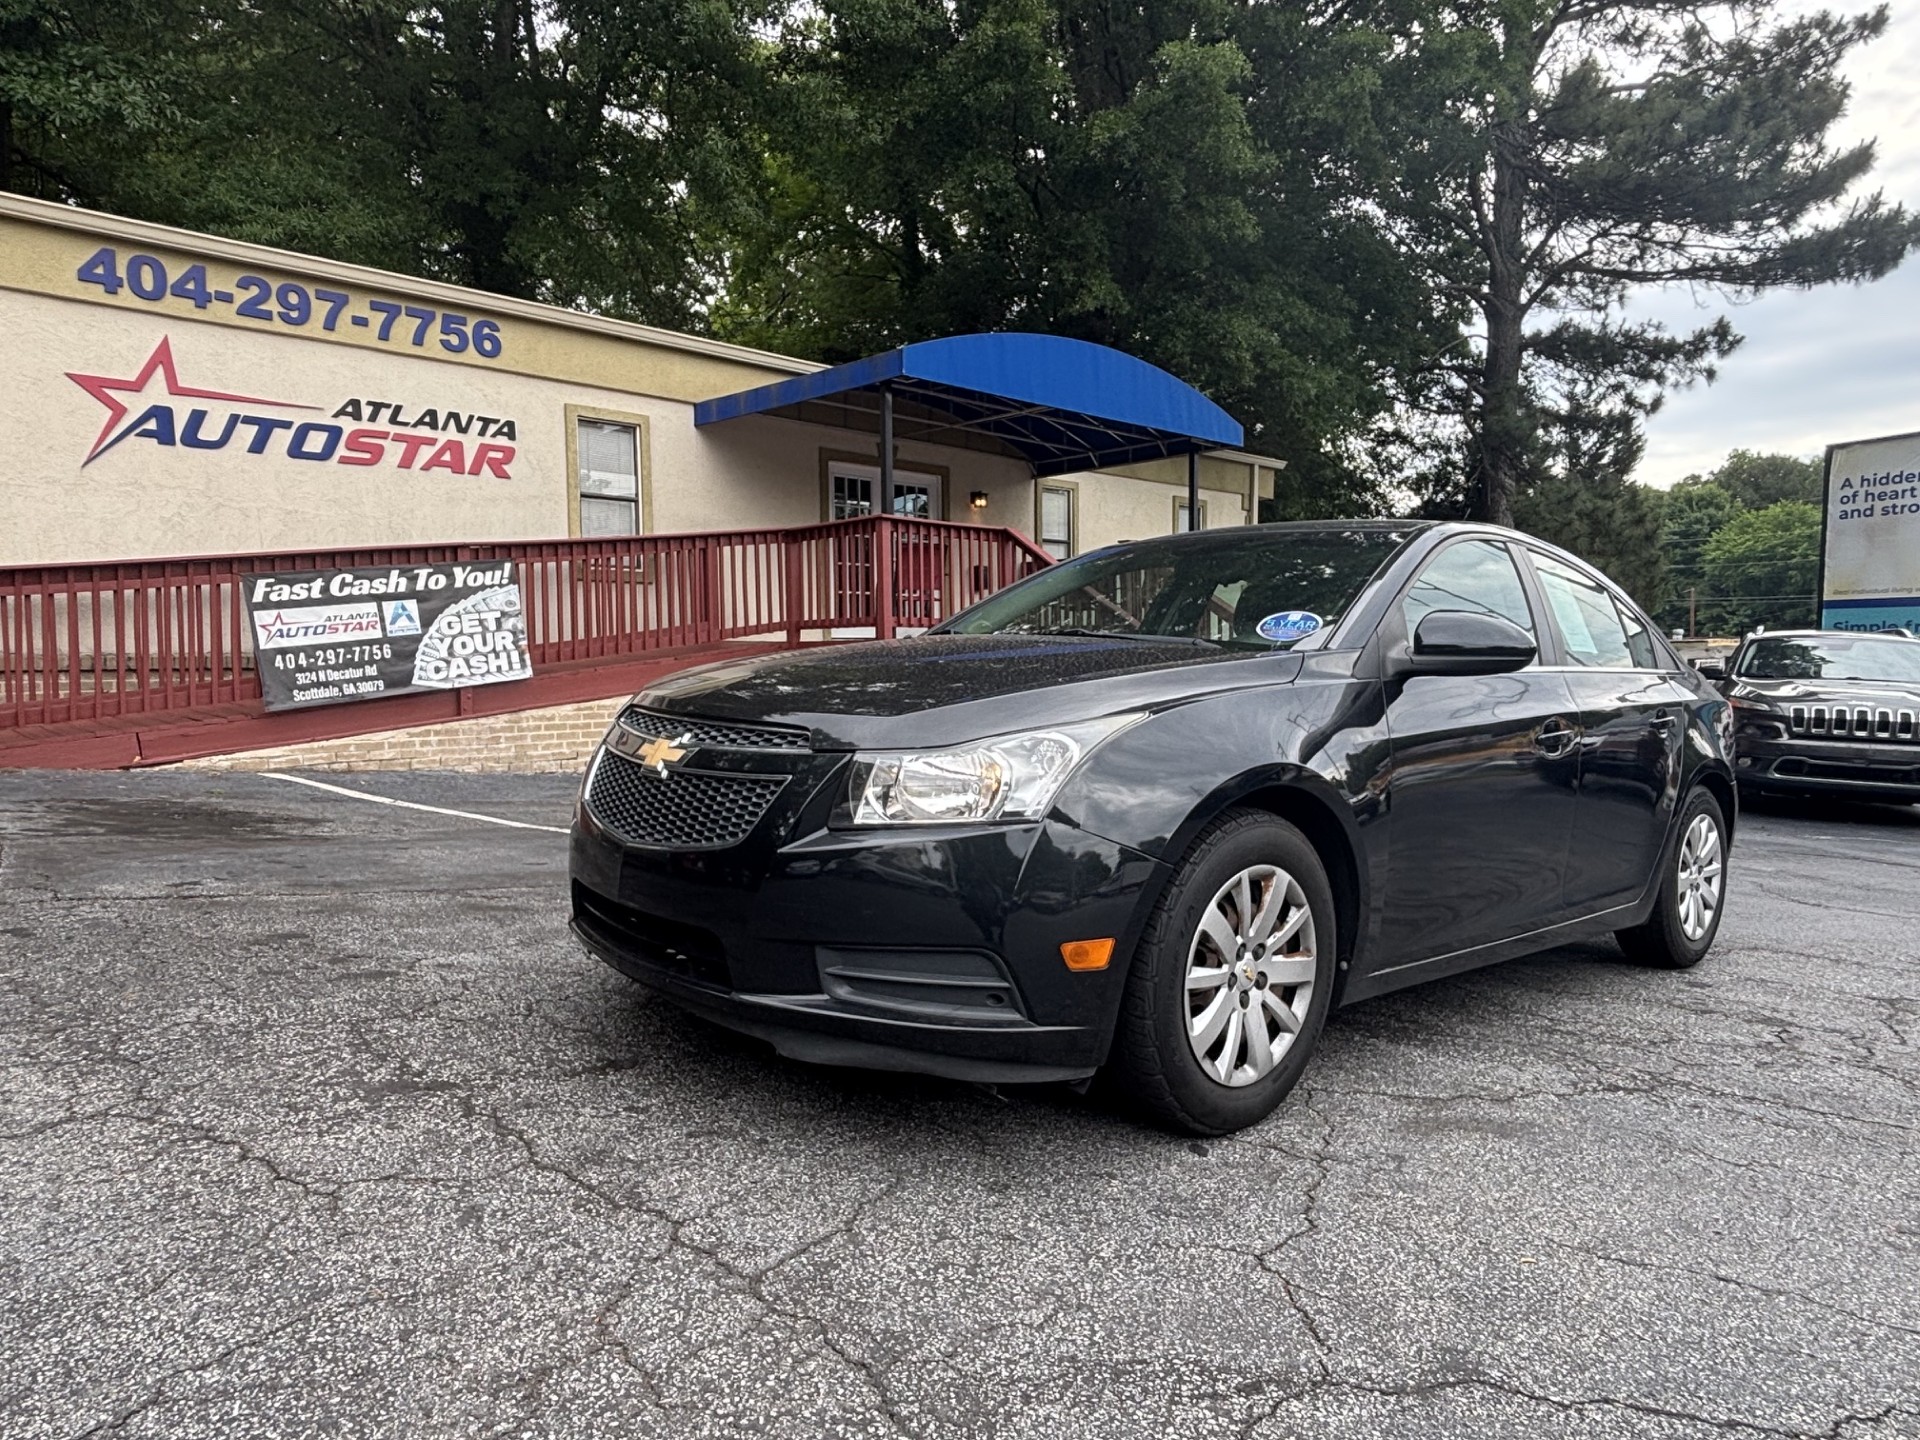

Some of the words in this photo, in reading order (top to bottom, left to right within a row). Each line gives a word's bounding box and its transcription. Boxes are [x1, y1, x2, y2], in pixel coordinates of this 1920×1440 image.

[76, 247, 503, 358] 404-297-7756
[331, 398, 517, 441] ATLANTA
[88, 404, 517, 479] AUTOSTAR
[1840, 477, 1854, 490] A
[1840, 490, 1859, 505] of
[1864, 486, 1917, 503] heart
[1839, 504, 1874, 520] and
[251, 577, 325, 603] Fast
[329, 569, 408, 597] Cash
[413, 568, 447, 591] To
[452, 562, 512, 588] You!
[268, 620, 379, 640] AUTOSTAR
[324, 611, 379, 623] ATLANTA
[438, 610, 502, 636] GET
[274, 643, 392, 670] 404-297-7756
[432, 630, 516, 659] YOUR
[295, 671, 317, 684] 3124
[318, 669, 326, 682] N
[326, 667, 364, 681] Decatur
[364, 664, 378, 676] Rd
[425, 649, 521, 681] CASH!
[293, 685, 342, 702] Scottdale,
[342, 682, 357, 695] GA
[356, 679, 385, 693] 30079
